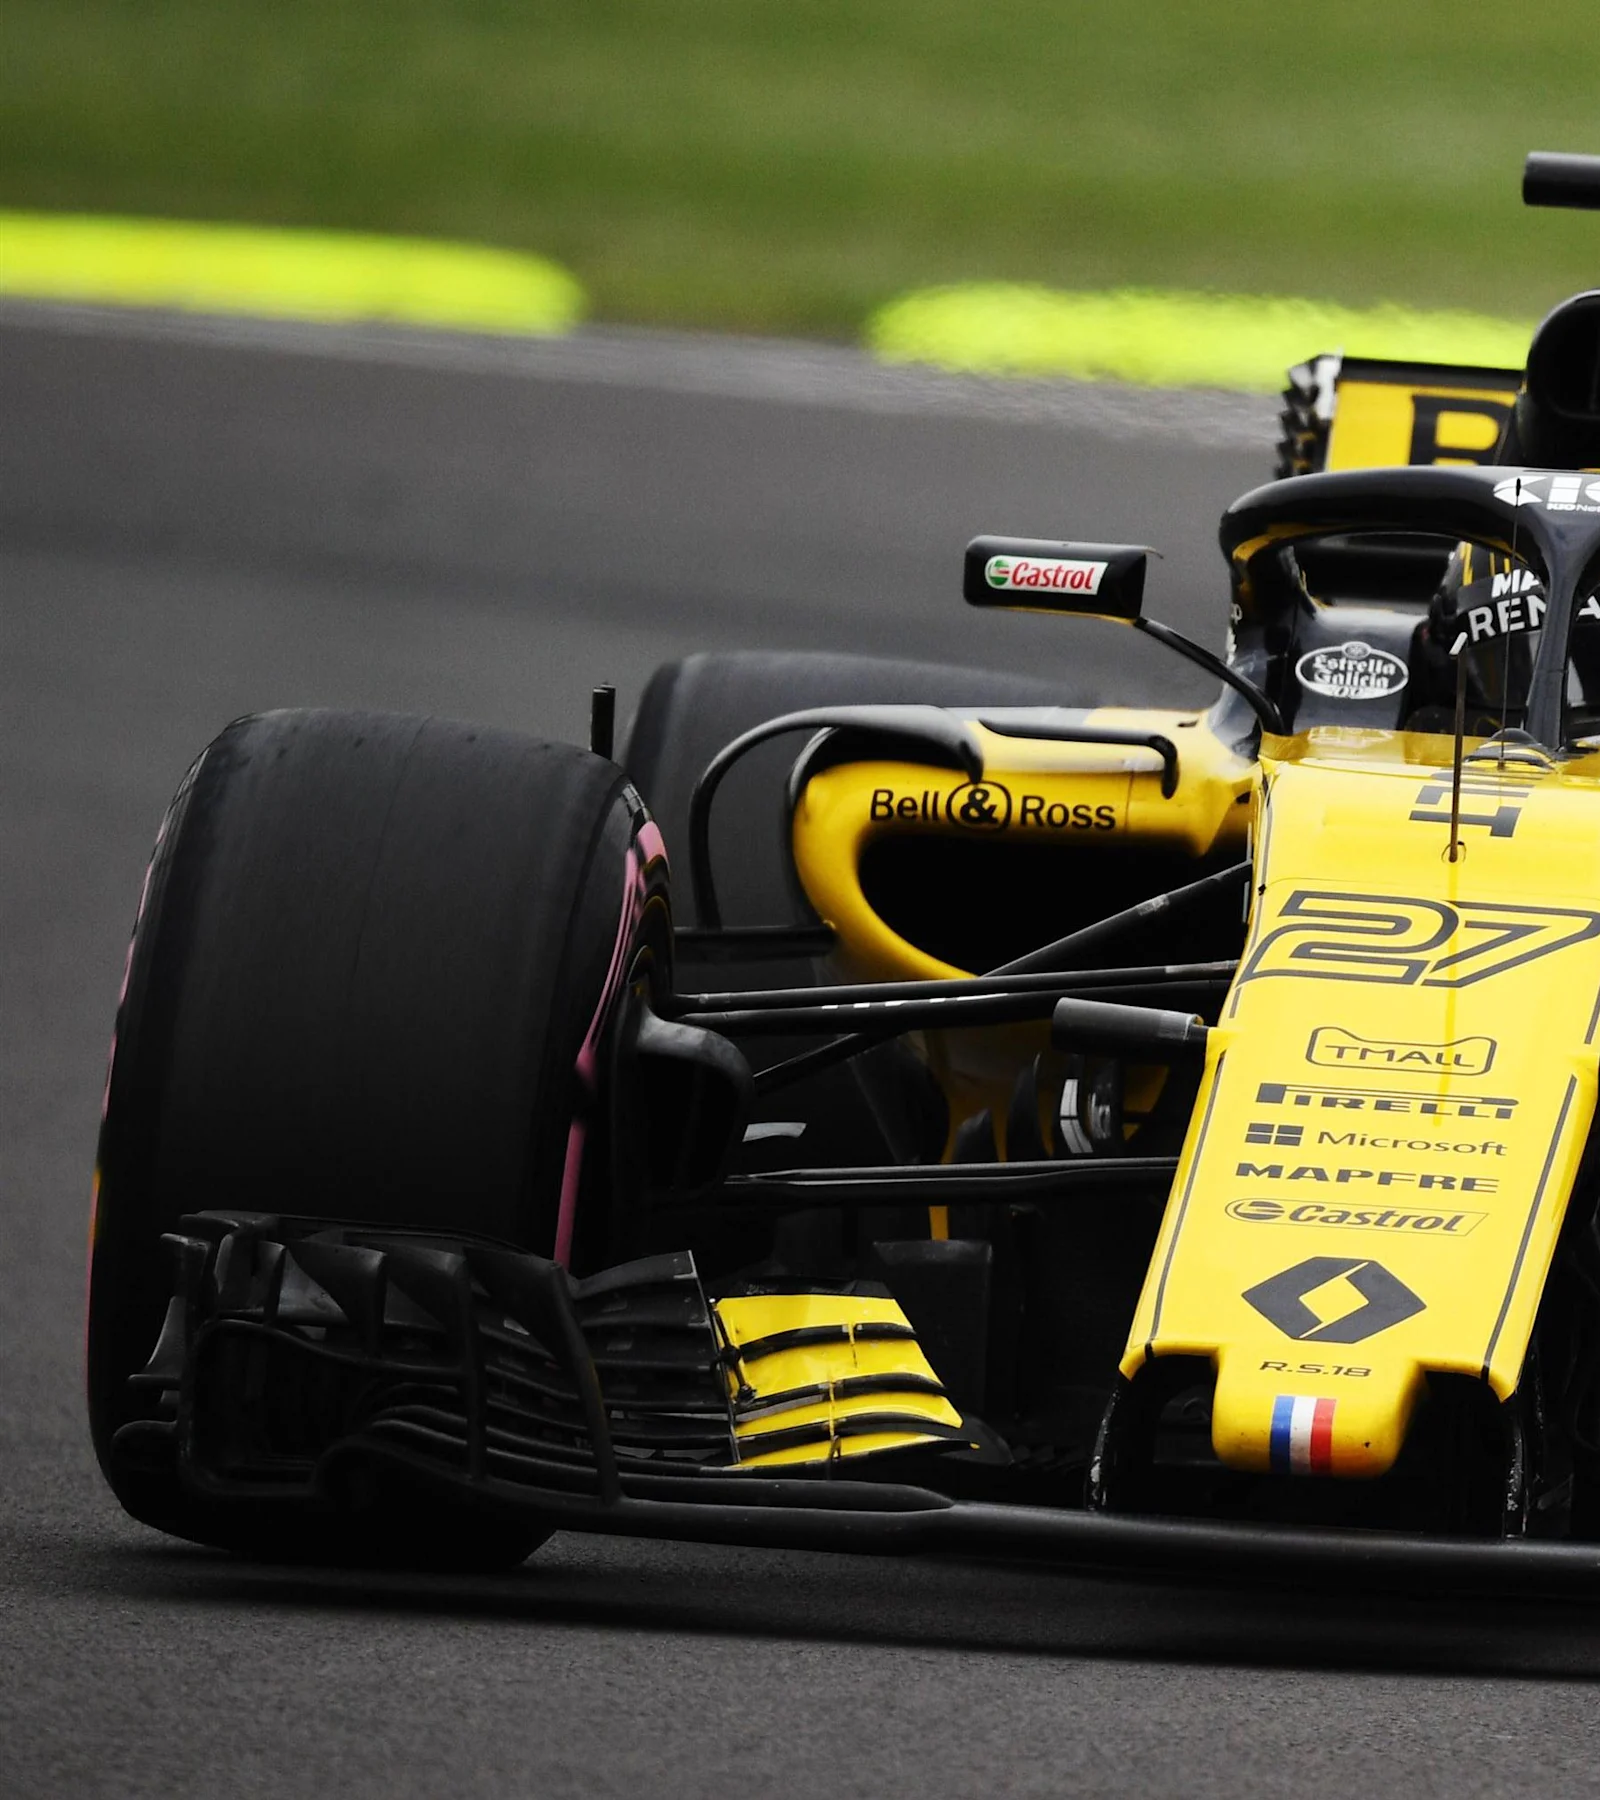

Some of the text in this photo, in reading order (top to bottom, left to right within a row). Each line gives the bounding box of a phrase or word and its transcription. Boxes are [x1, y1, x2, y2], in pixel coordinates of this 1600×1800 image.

[1011, 561, 1095, 591] Castrol
[1312, 654, 1396, 676] Estrella
[1313, 669, 1389, 689] Galicia
[870, 787, 1117, 831] Bell & Ross
[1325, 1044, 1475, 1067] TMALL
[1255, 1082, 1519, 1119] PIRELLI
[1318, 1131, 1507, 1156] Microsoft
[1235, 1162, 1500, 1193] MAPFRE
[1289, 1200, 1466, 1232] Castrol
[1259, 1360, 1372, 1378] R.S.18
